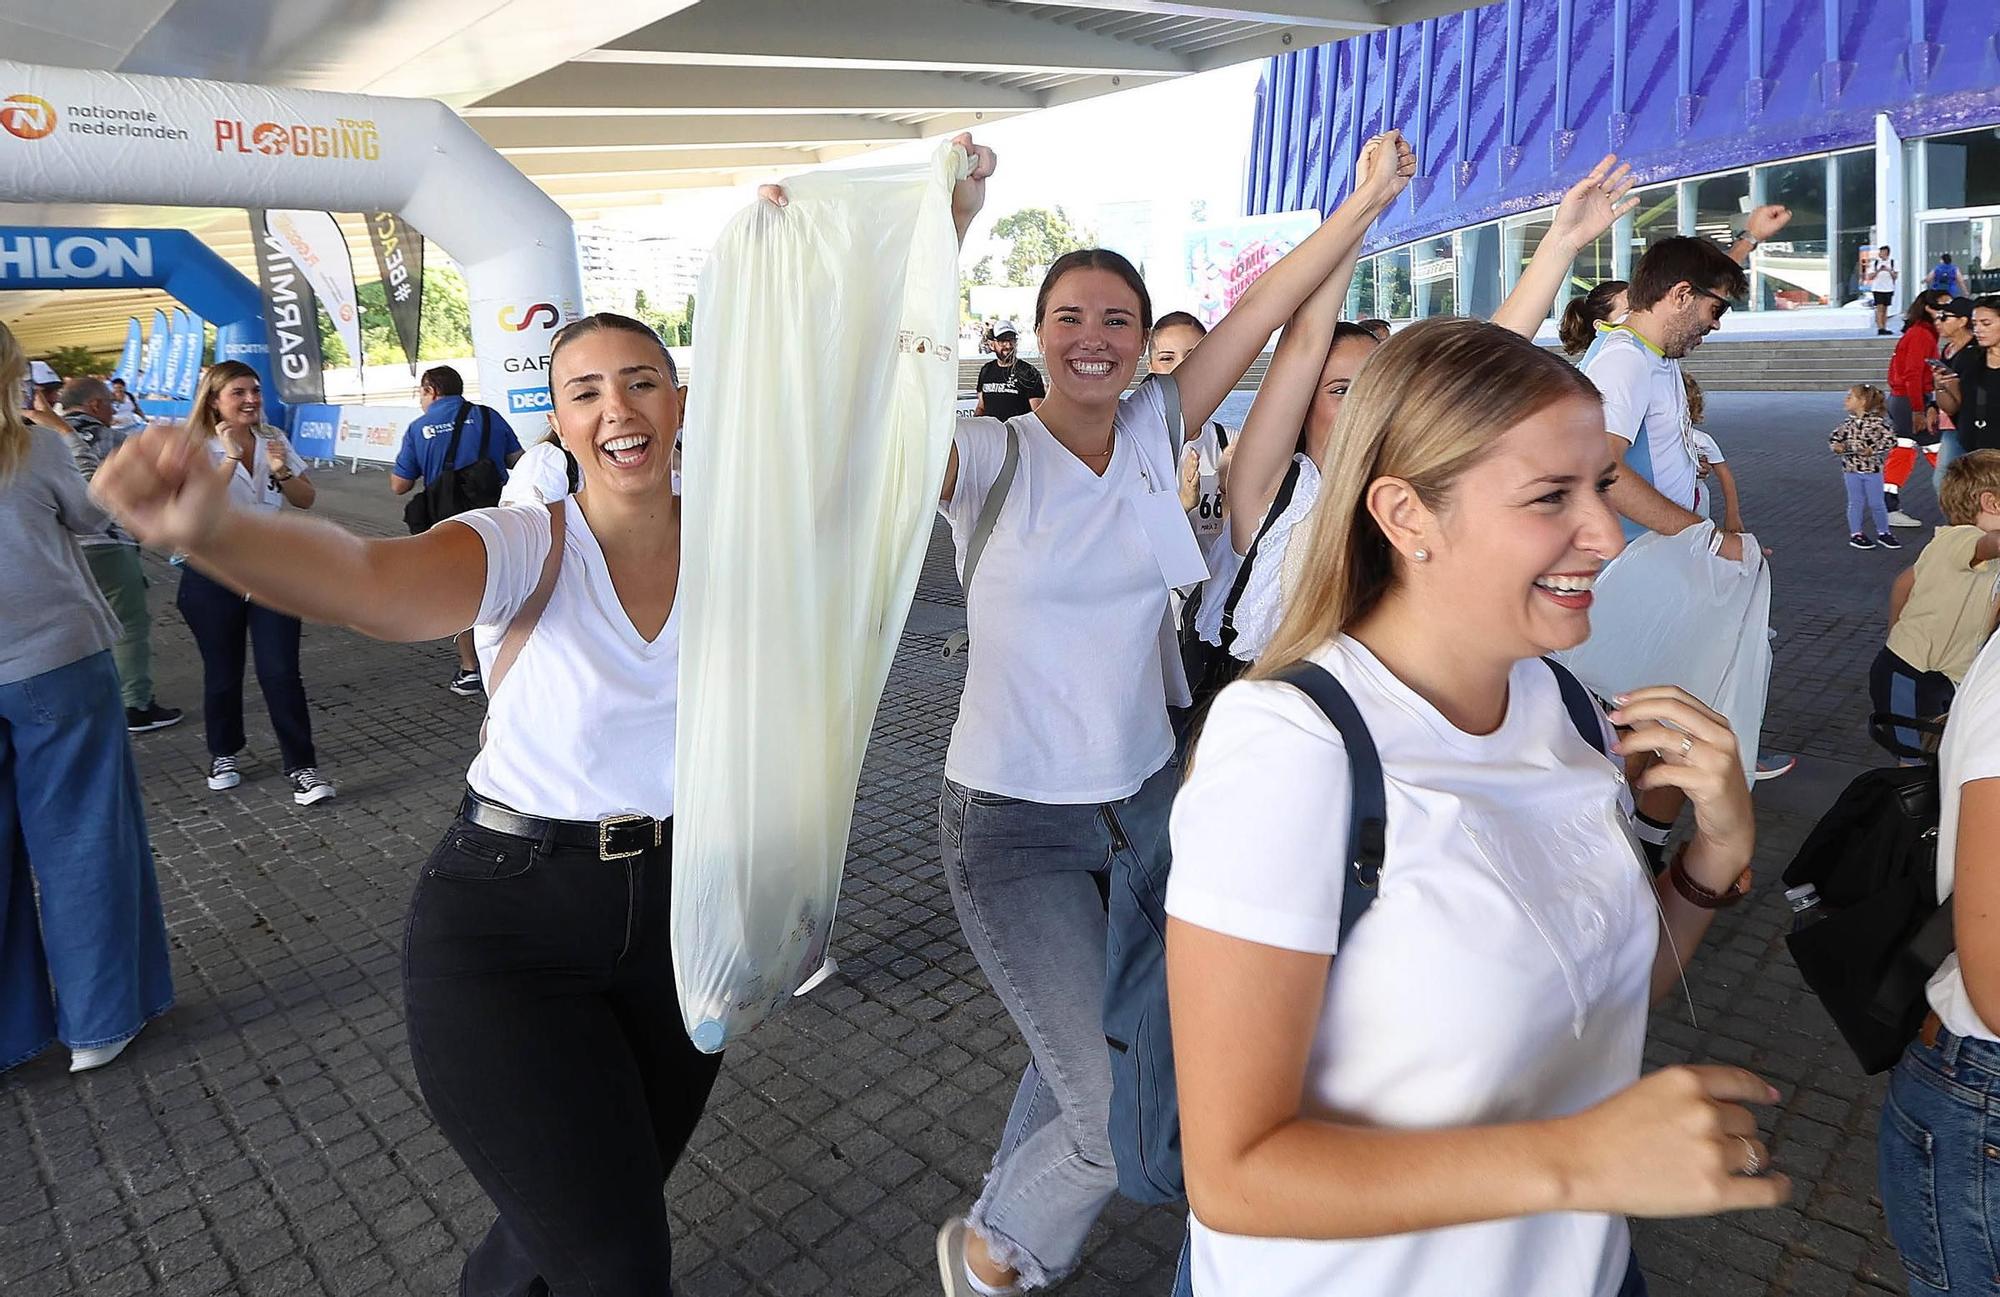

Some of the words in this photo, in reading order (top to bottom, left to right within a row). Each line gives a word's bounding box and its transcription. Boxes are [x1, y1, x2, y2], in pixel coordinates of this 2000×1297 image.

[68, 105, 157, 122] nationale
[69, 121, 189, 140] nederlanden
[337, 118, 376, 129] TOUR
[214, 119, 379, 160] PLOGGING
[0, 236, 153, 278] HLON
